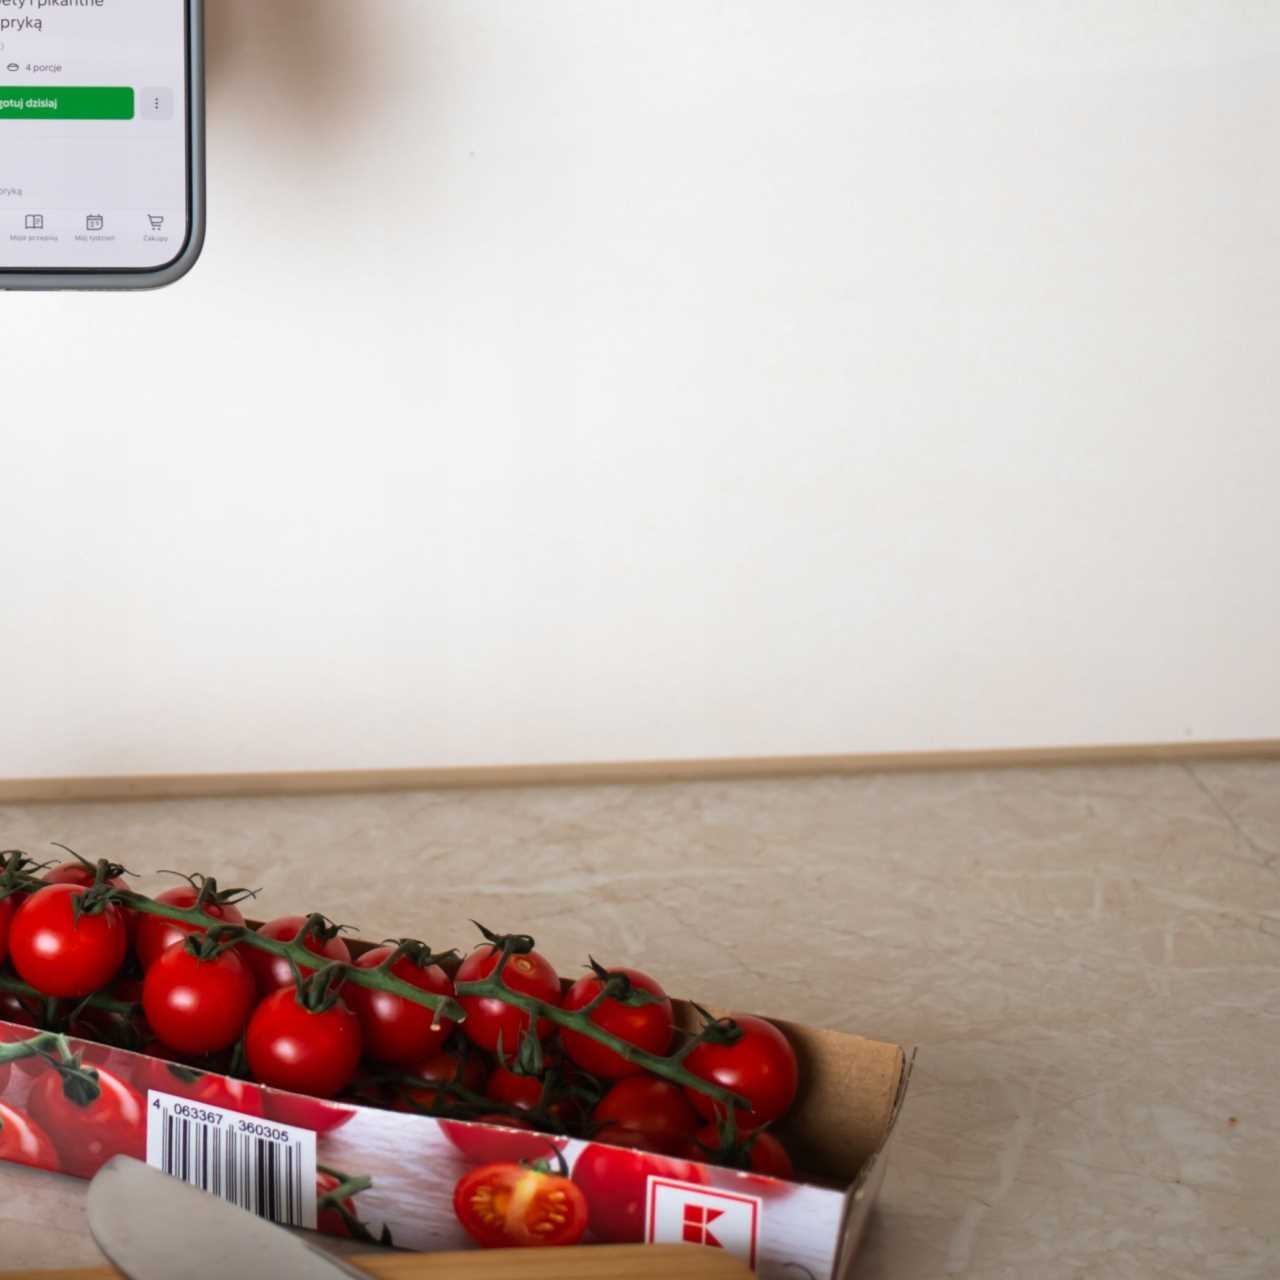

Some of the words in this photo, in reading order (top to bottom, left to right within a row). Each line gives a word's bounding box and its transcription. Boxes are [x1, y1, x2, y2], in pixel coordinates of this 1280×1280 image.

[25, 63, 32, 72] 4
[33, 63, 63, 74] porcje
[25, 97, 58, 110] dzisiaj
[152, 1098, 161, 1110] 4
[174, 1103, 224, 1125] 063367
[238, 1119, 289, 1143] 360305
